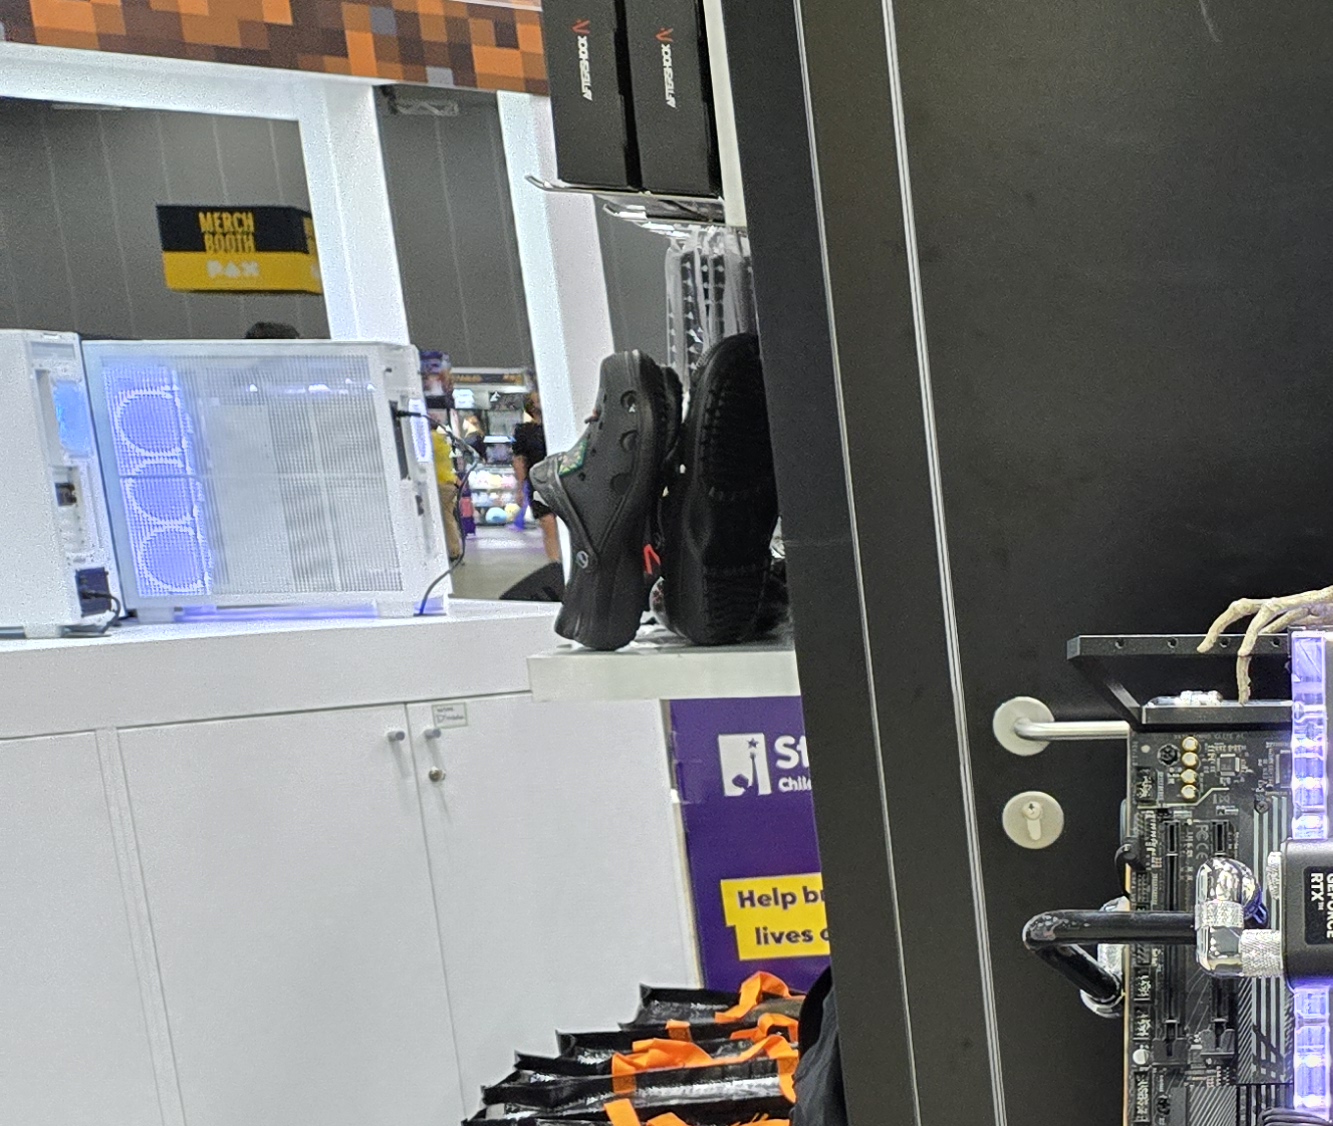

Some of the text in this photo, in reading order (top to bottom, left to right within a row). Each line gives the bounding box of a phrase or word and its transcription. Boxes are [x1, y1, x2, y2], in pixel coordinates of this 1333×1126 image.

[577, 36, 593, 101] AFTERSHOCK
[661, 44, 677, 109] AFTERSHOCK
[198, 211, 255, 233] MERCH
[204, 233, 256, 254] BOOTH
[738, 887, 798, 911] Help
[755, 926, 813, 946] lives
